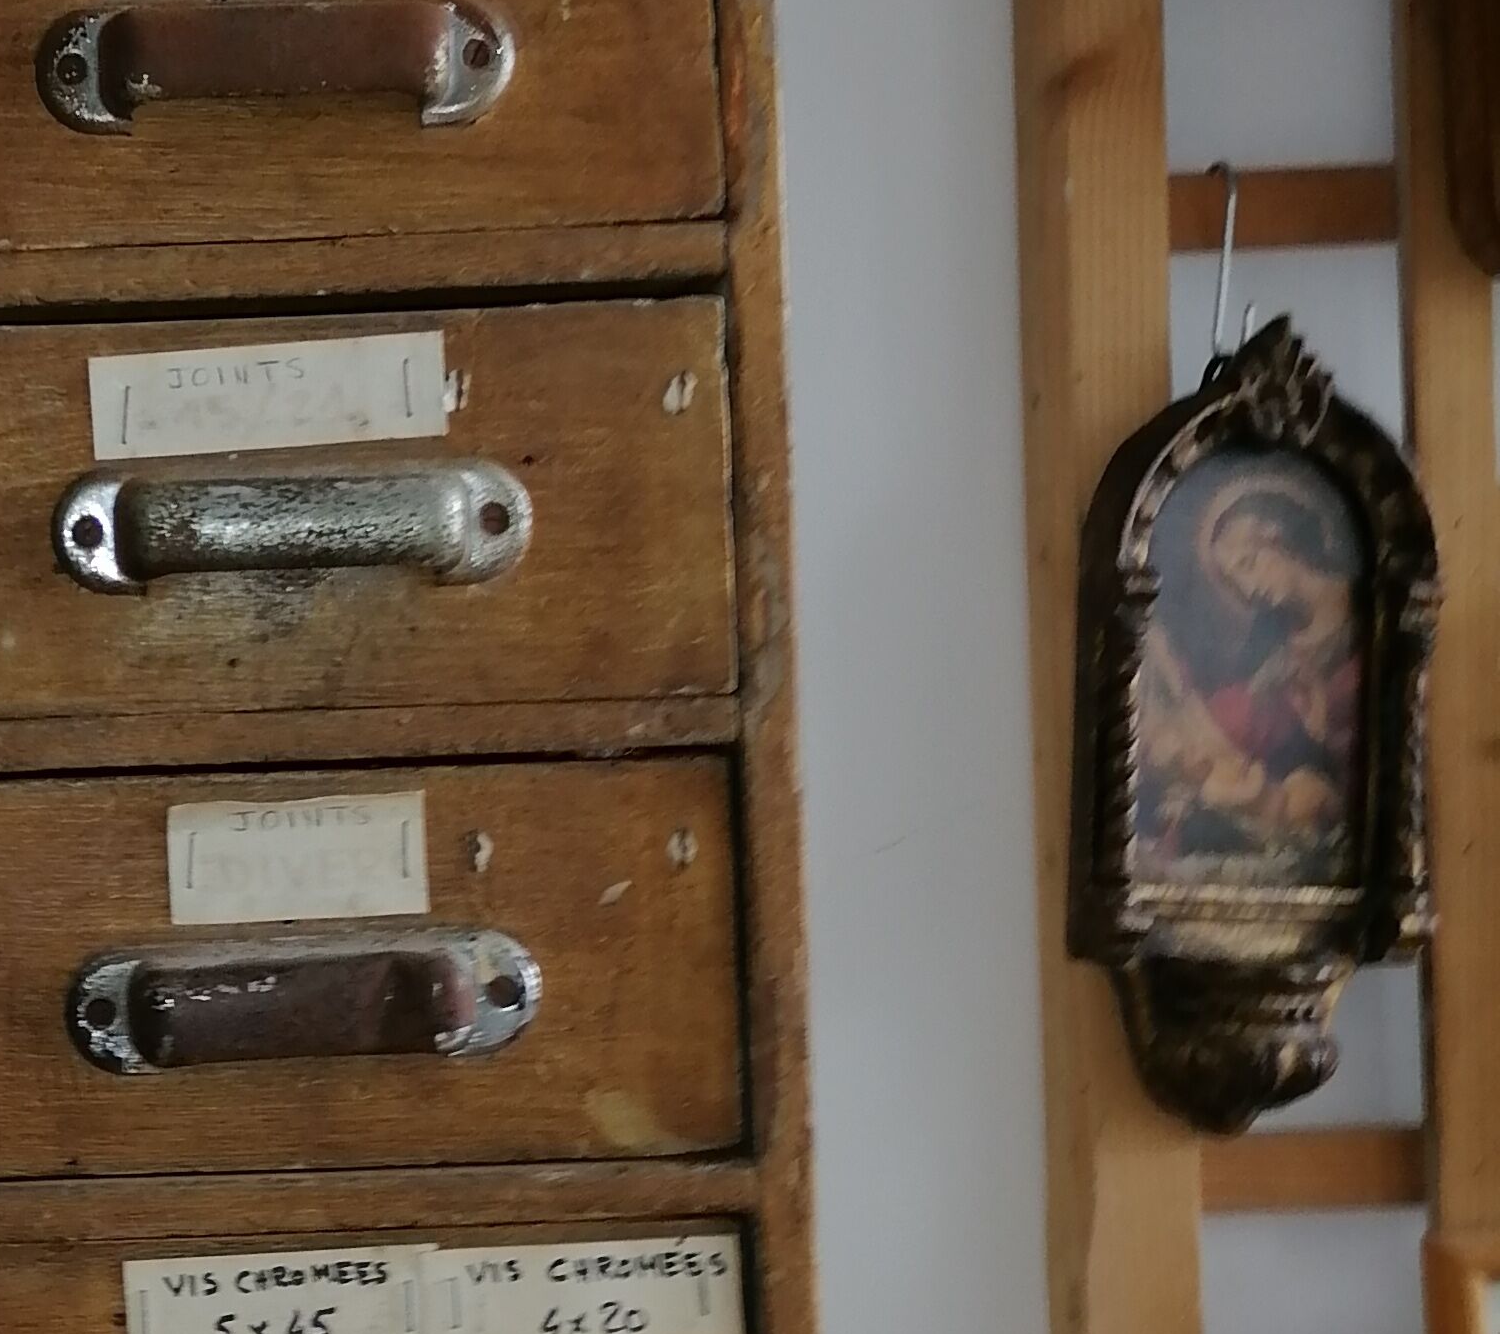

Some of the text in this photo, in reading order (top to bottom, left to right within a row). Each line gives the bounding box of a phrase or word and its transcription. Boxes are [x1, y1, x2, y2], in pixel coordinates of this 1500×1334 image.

[165, 356, 304, 389] JOINTS
[230, 805, 373, 833] JOINTS
[463, 1258, 522, 1283] VIS
[163, 1272, 218, 1297] VIS
